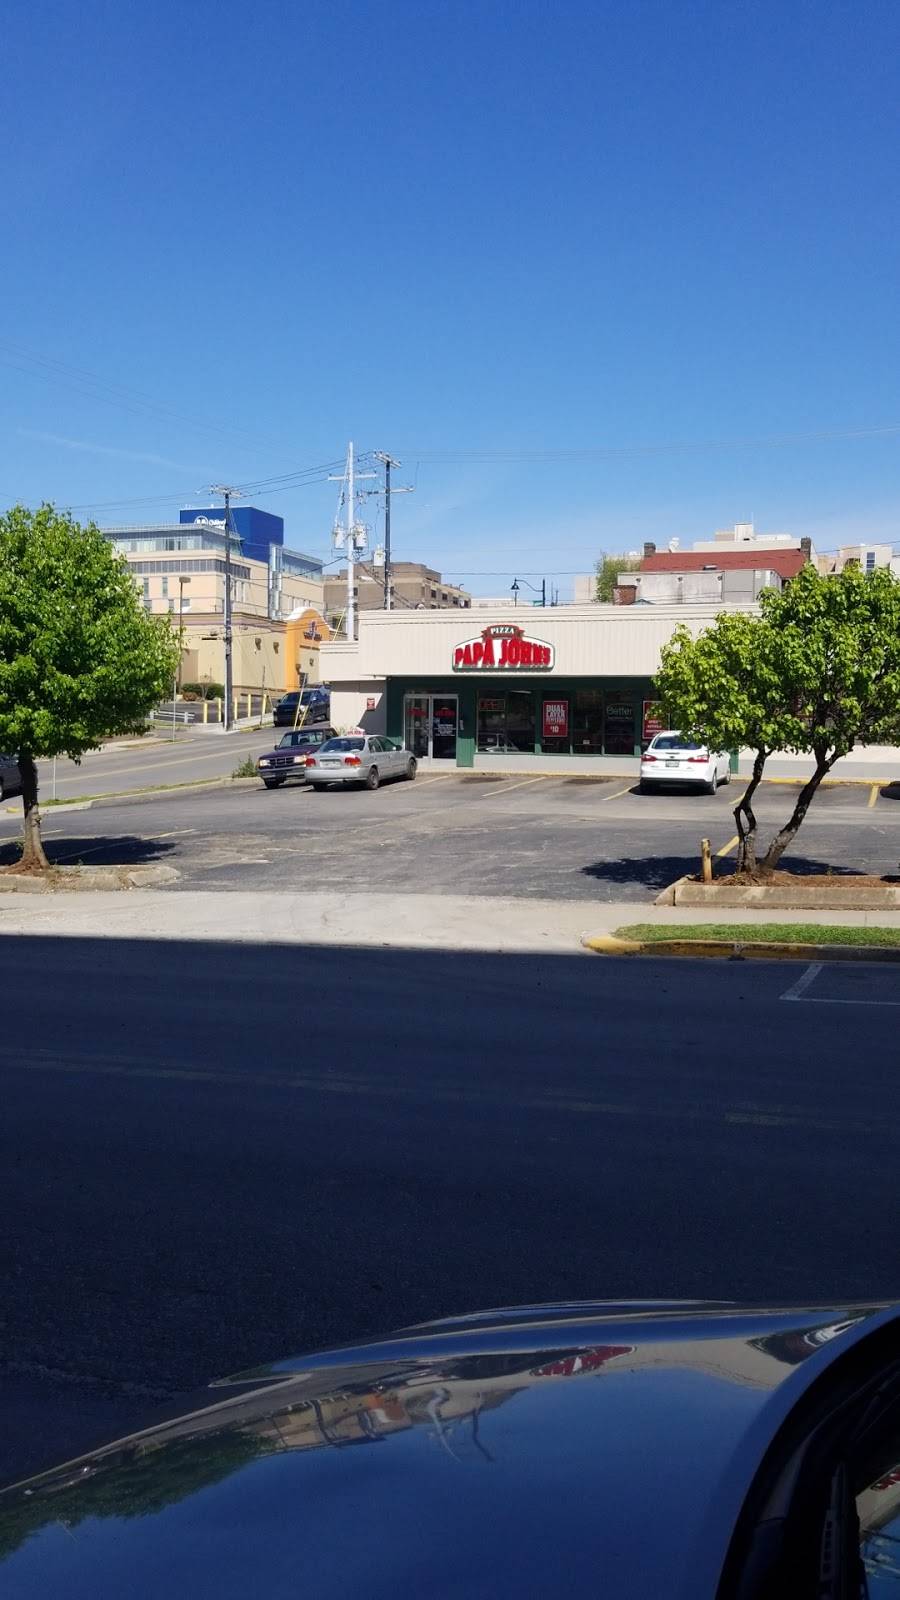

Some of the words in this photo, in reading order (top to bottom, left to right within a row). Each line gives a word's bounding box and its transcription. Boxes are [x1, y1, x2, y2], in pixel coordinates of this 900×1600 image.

[490, 627, 514, 635] PIZZA
[454, 637, 495, 665] PAPA
[546, 704, 566, 712] DUAL
